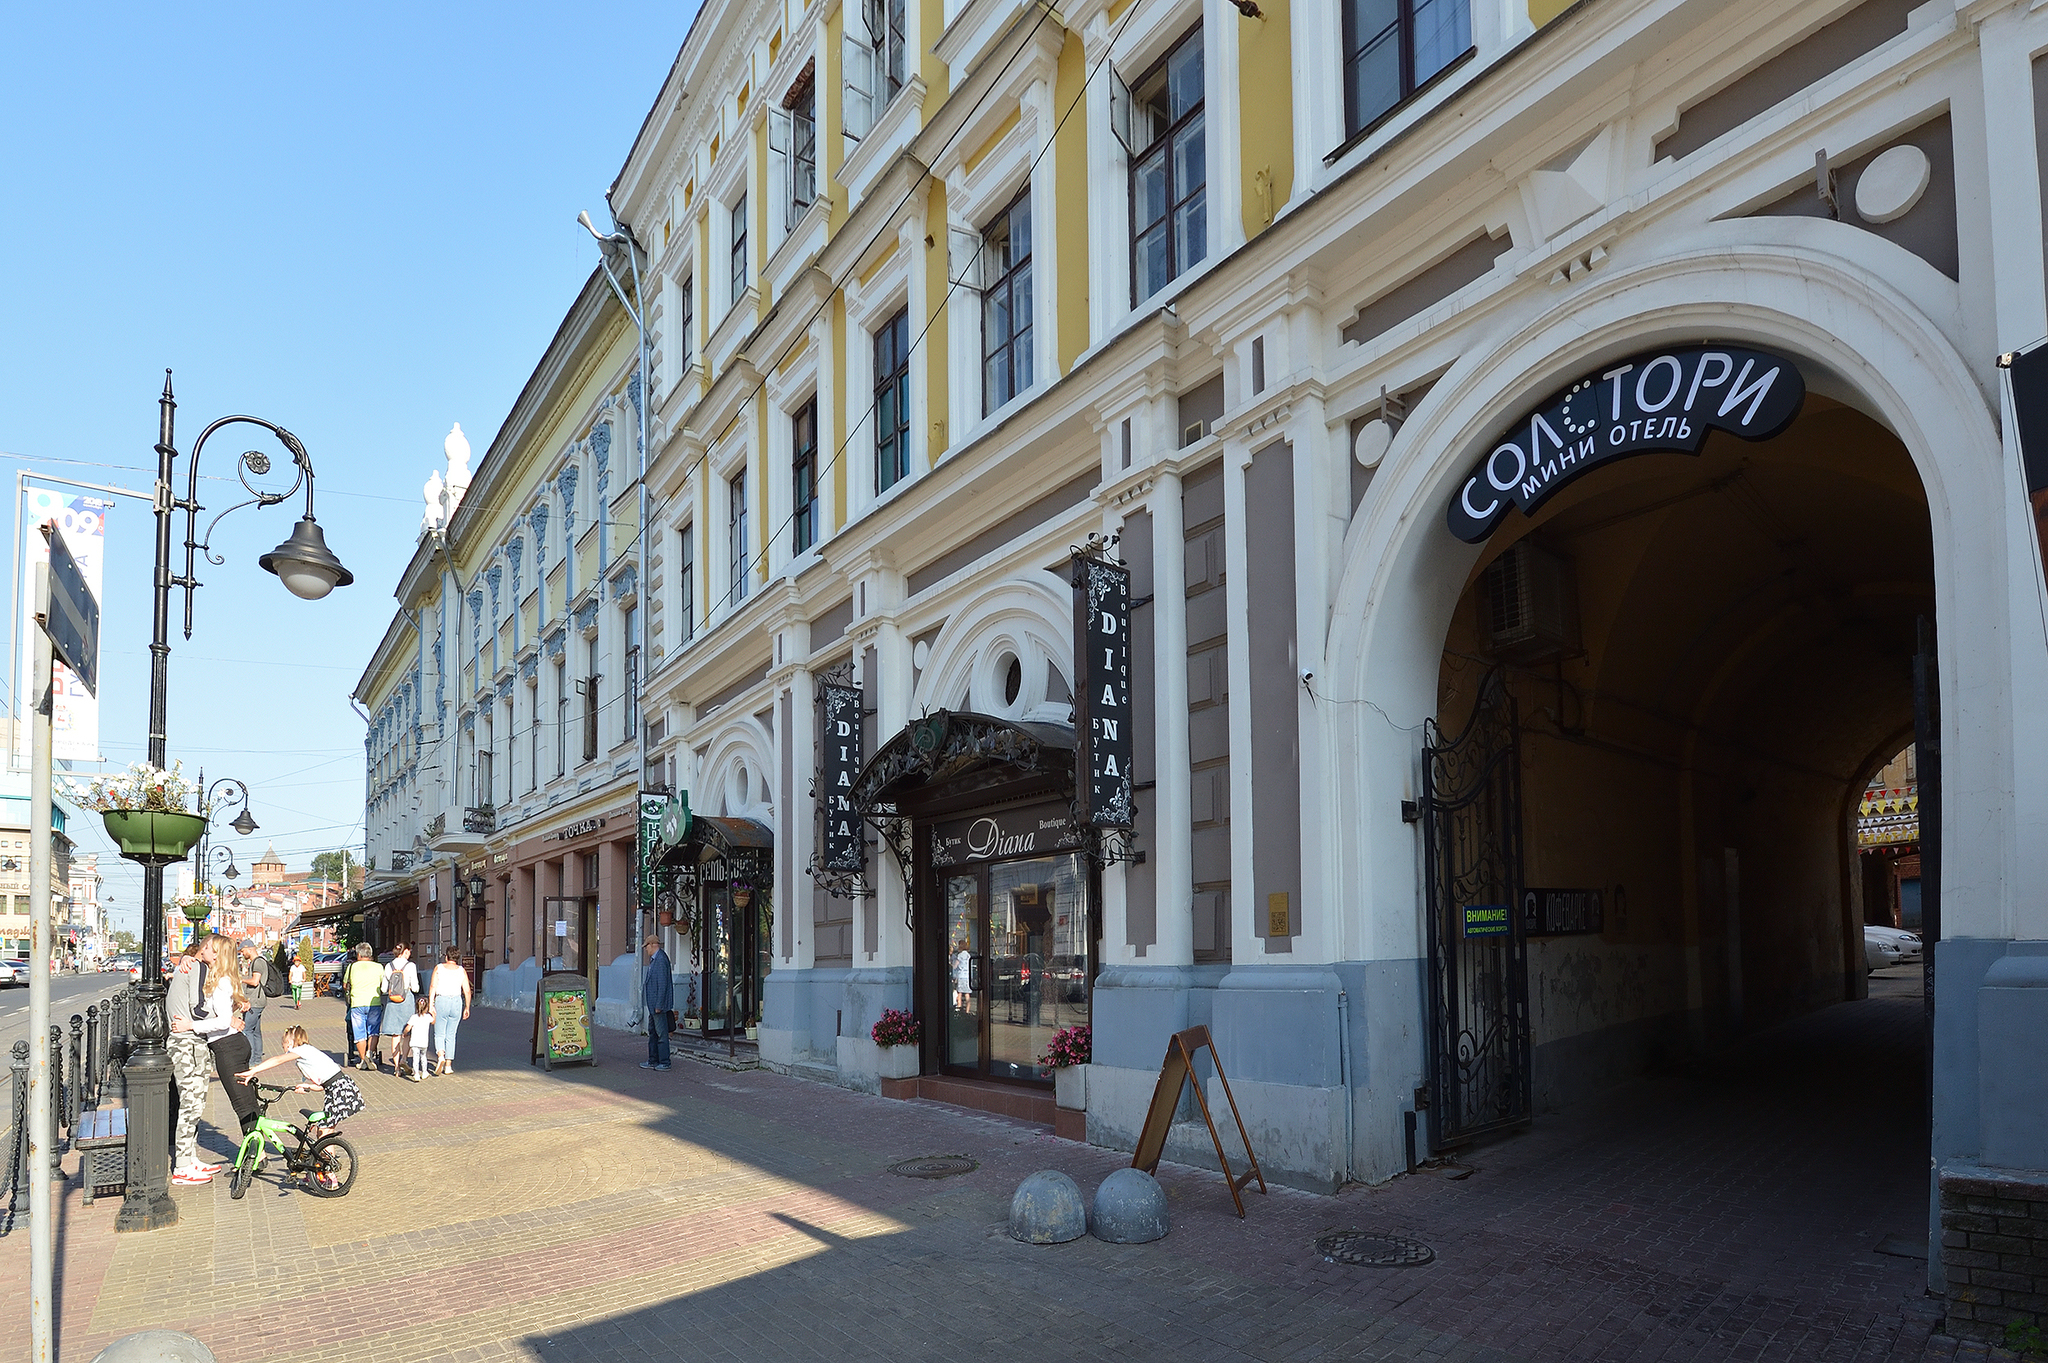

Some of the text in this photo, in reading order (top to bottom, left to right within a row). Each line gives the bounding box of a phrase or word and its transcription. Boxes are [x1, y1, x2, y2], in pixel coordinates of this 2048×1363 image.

[1521, 416, 1692, 499] МИНИ ОТЕЛЬ
[1101, 611, 1120, 778] DIANA
[837, 720, 851, 836] DIANA
[1092, 717, 1100, 795] Бутик
[945, 817, 1067, 860] Бутик Diana Boutique
[1466, 909, 1508, 922] ВНИМАНИЕ!
